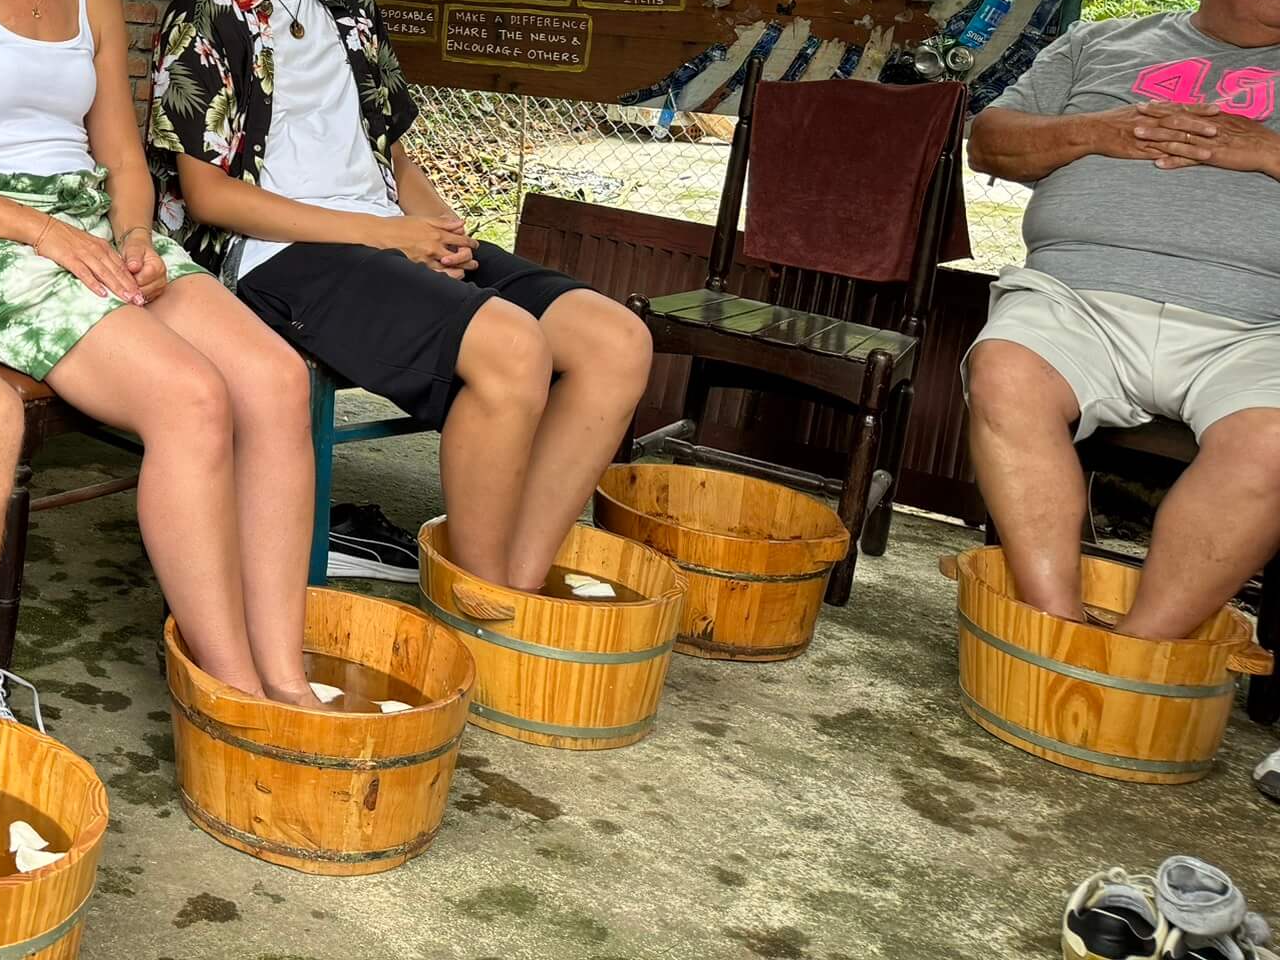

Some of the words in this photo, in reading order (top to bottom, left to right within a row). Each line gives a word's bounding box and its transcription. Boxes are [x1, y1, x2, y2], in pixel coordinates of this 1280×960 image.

[455, 11, 487, 22] MAKE
[494, 15, 503, 24] A
[510, 15, 588, 30] DIFFERENCE
[447, 23, 489, 39] SHARE
[498, 29, 524, 41] THE
[529, 32, 567, 44] NEWS
[446, 40, 523, 58] ENCOURAGE
[527, 49, 580, 64] OTHERS
